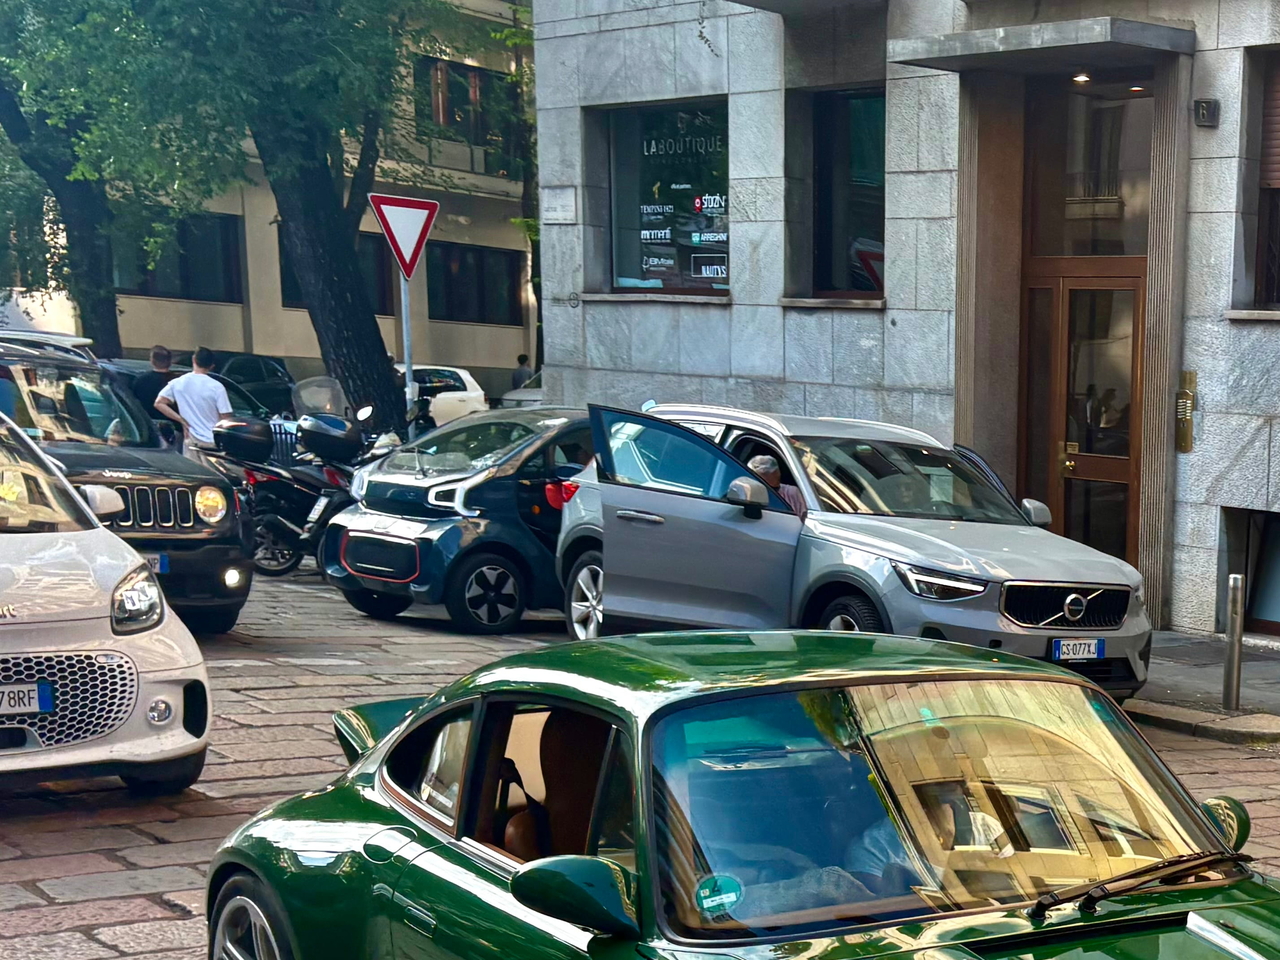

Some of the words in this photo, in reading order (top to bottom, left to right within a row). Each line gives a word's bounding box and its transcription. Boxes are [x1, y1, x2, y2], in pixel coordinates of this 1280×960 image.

[1199, 102, 1207, 122] 6
[643, 136, 723, 156] LABOUTIQUE
[102, 469, 132, 479] Jeep
